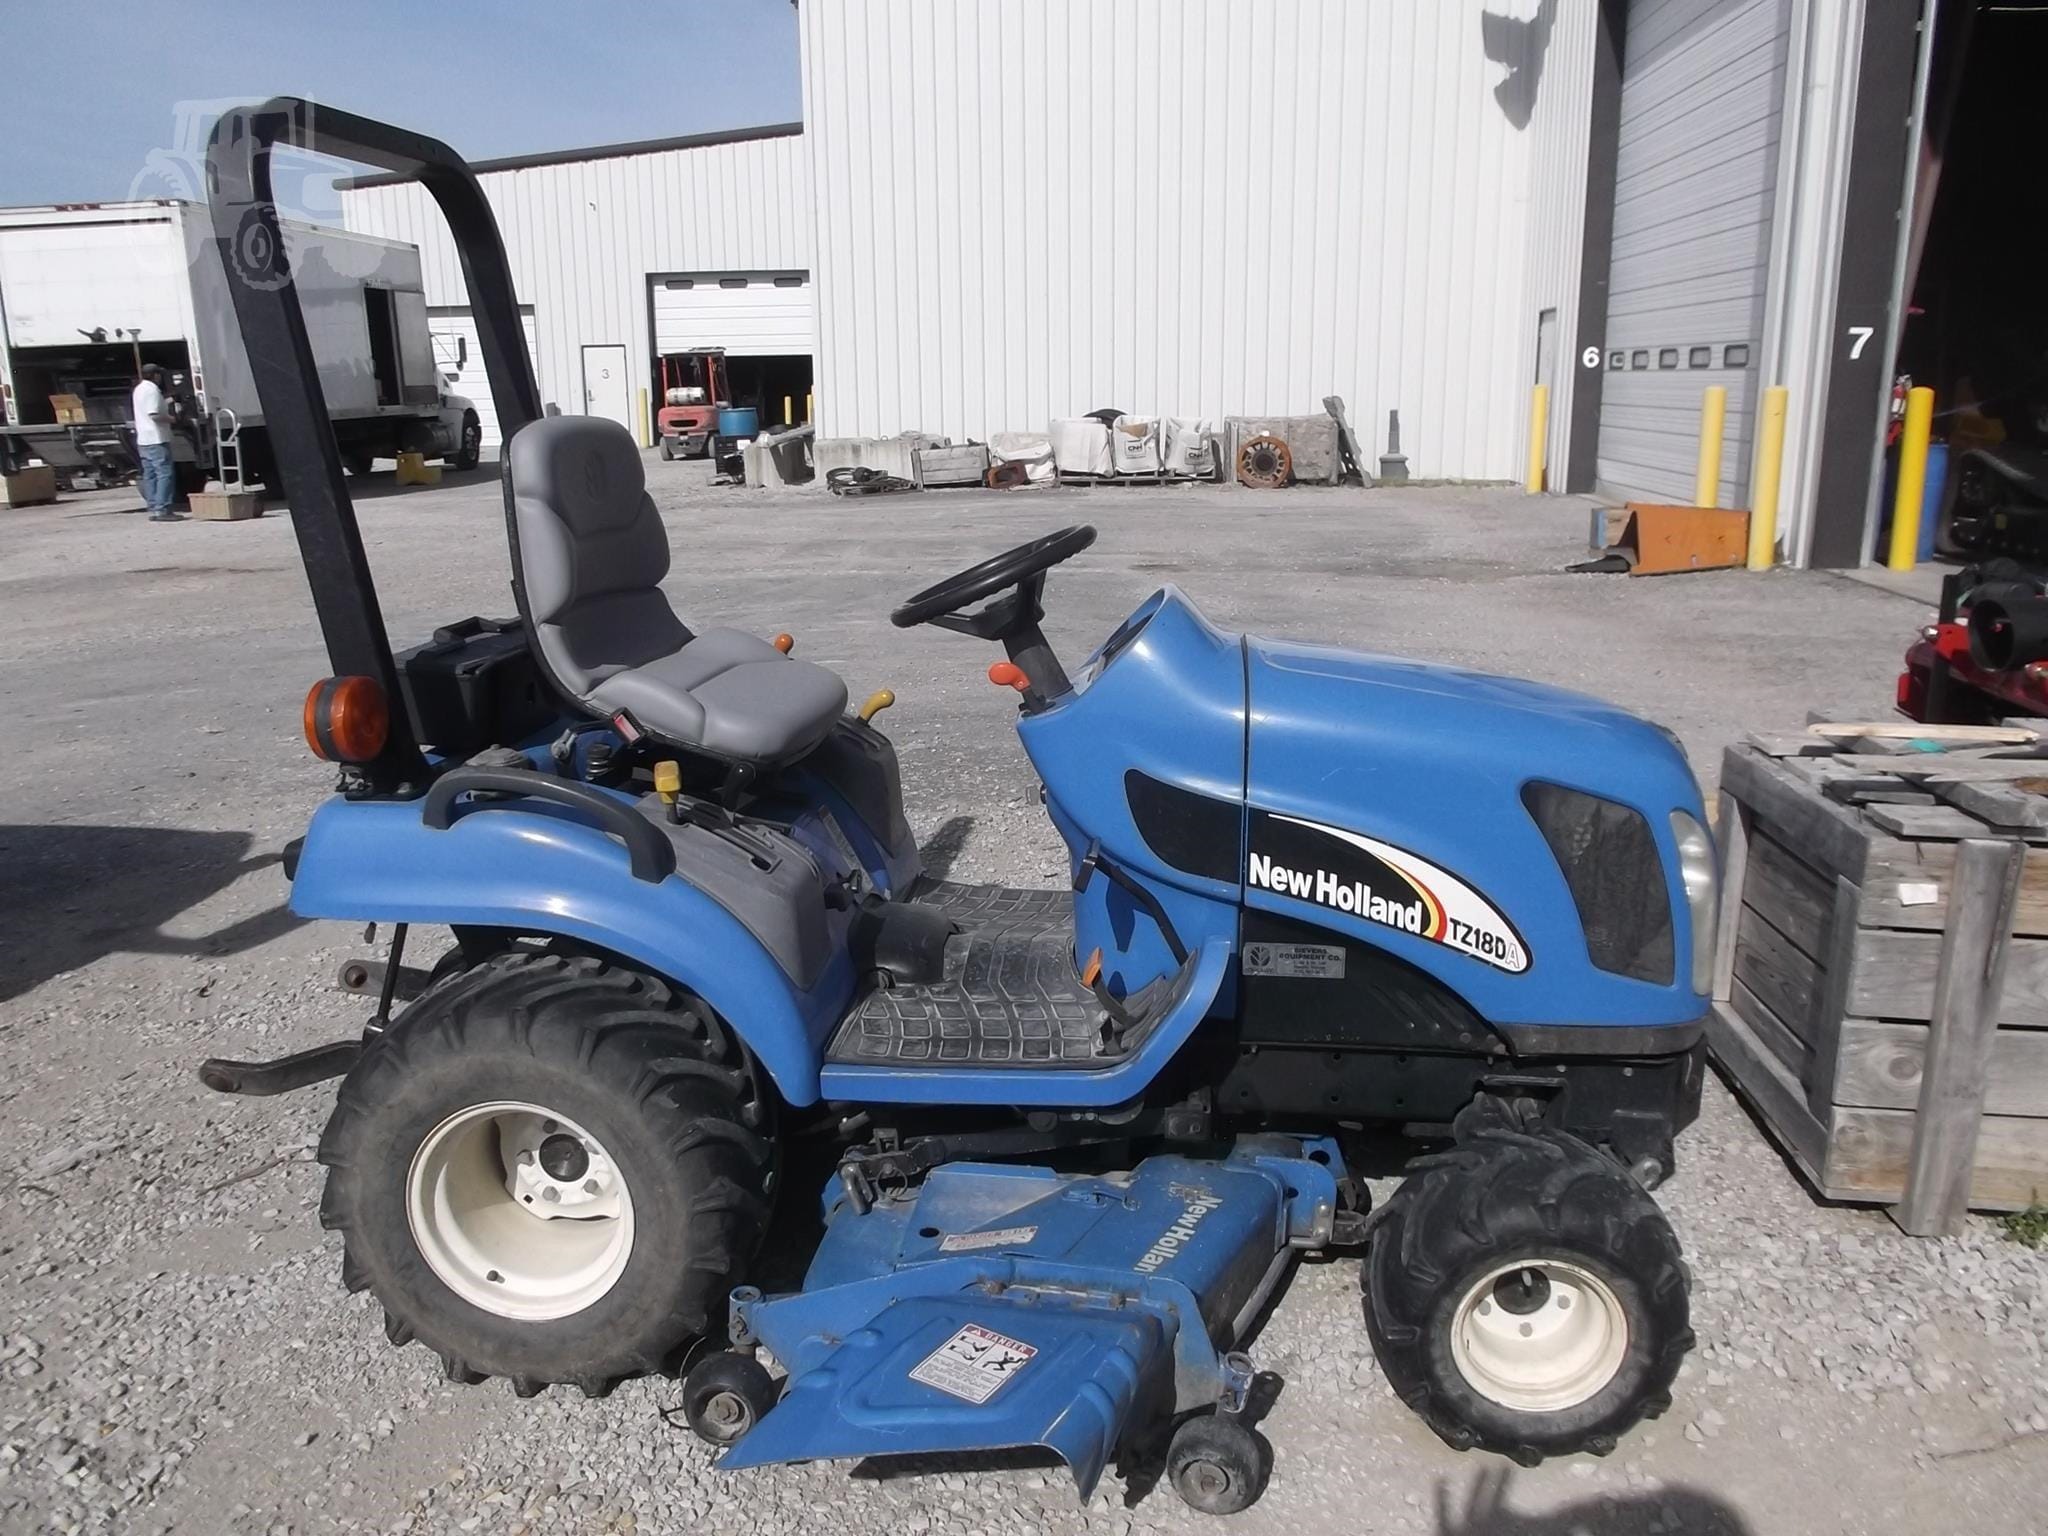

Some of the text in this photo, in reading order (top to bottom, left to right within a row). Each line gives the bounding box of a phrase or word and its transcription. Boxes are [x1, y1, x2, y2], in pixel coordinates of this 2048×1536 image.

[1848, 327, 1874, 360] 7
[1582, 347, 1600, 368] 6
[602, 368, 610, 379] 3
[1250, 853, 1422, 935] New Holland
[1279, 952, 1325, 961] EQUIPMENT
[1133, 1194, 1223, 1273] New Hollan
[985, 1331, 1028, 1354] DANGER
